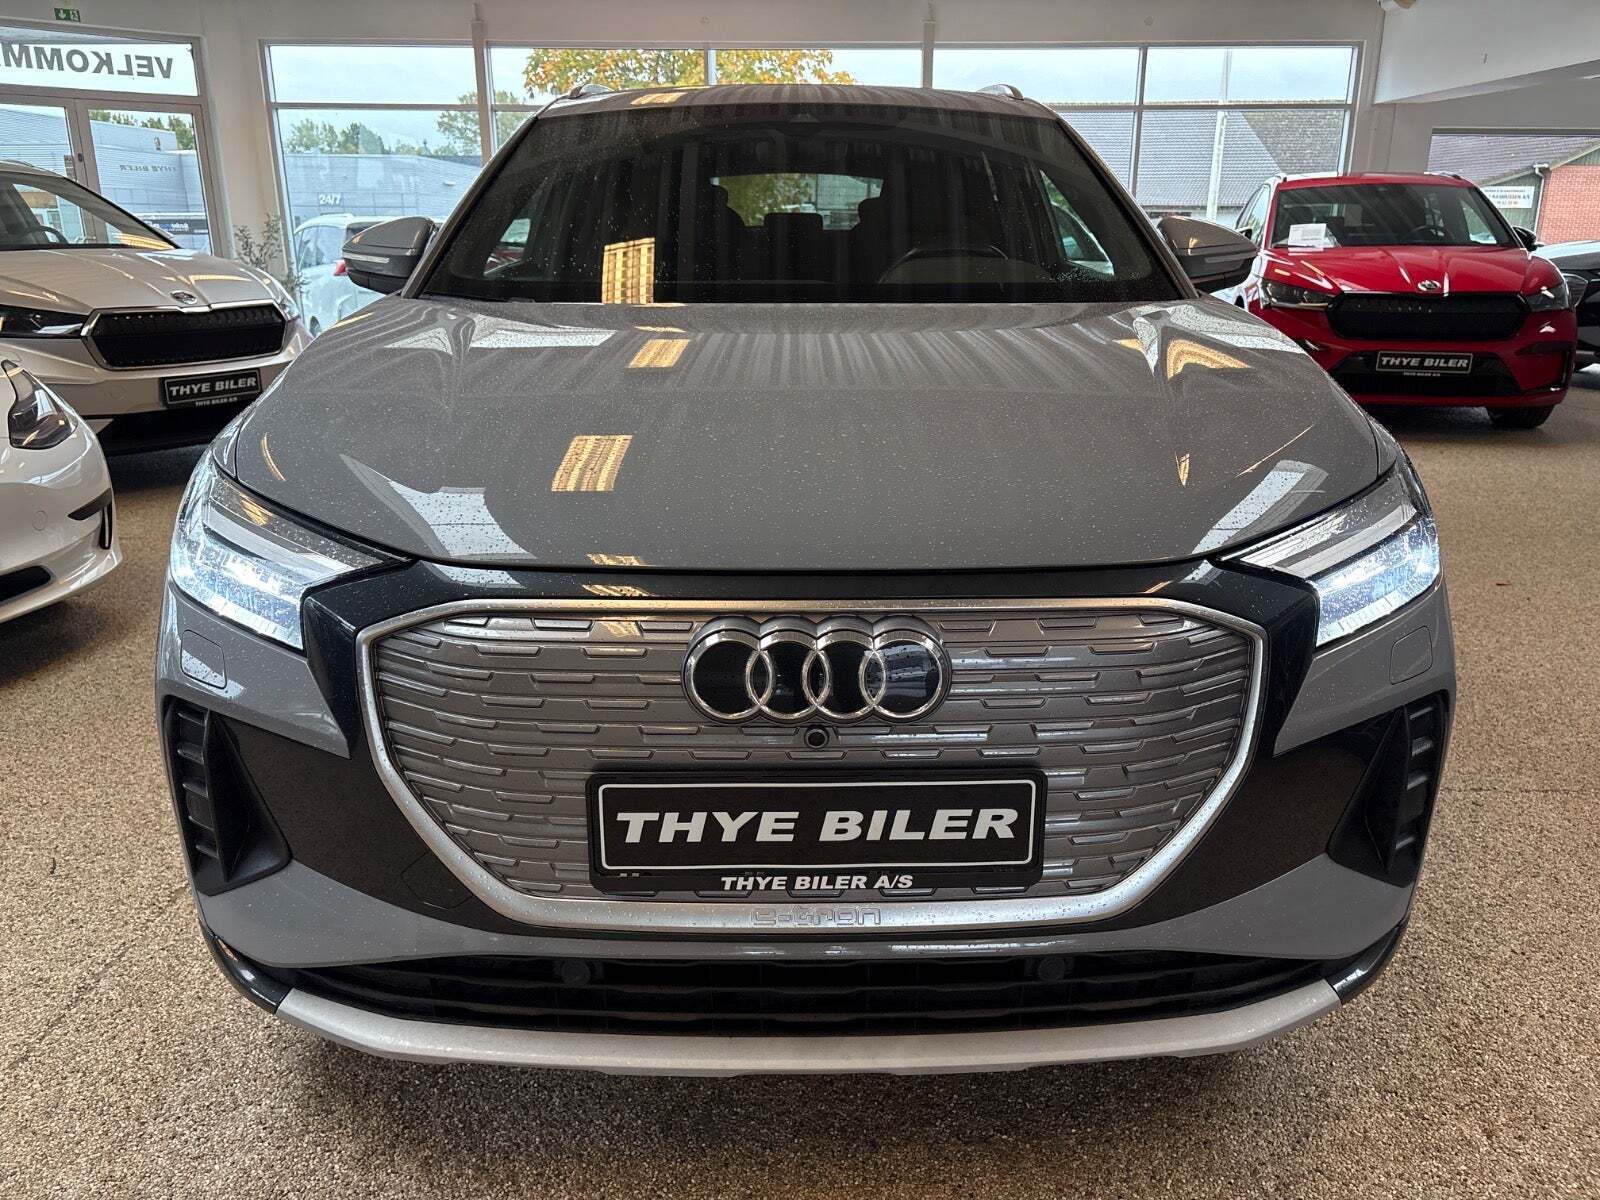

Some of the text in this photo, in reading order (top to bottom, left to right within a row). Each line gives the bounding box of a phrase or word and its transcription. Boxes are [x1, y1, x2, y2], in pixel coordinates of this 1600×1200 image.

[319, 193, 341, 206] 24/7
[1381, 356, 1468, 368] THYE BILER
[169, 377, 256, 397] THYE BILER
[616, 808, 1018, 844] THYE BILER
[721, 874, 914, 890] THYE BILER A/S
[750, 906, 881, 926] e-tron
